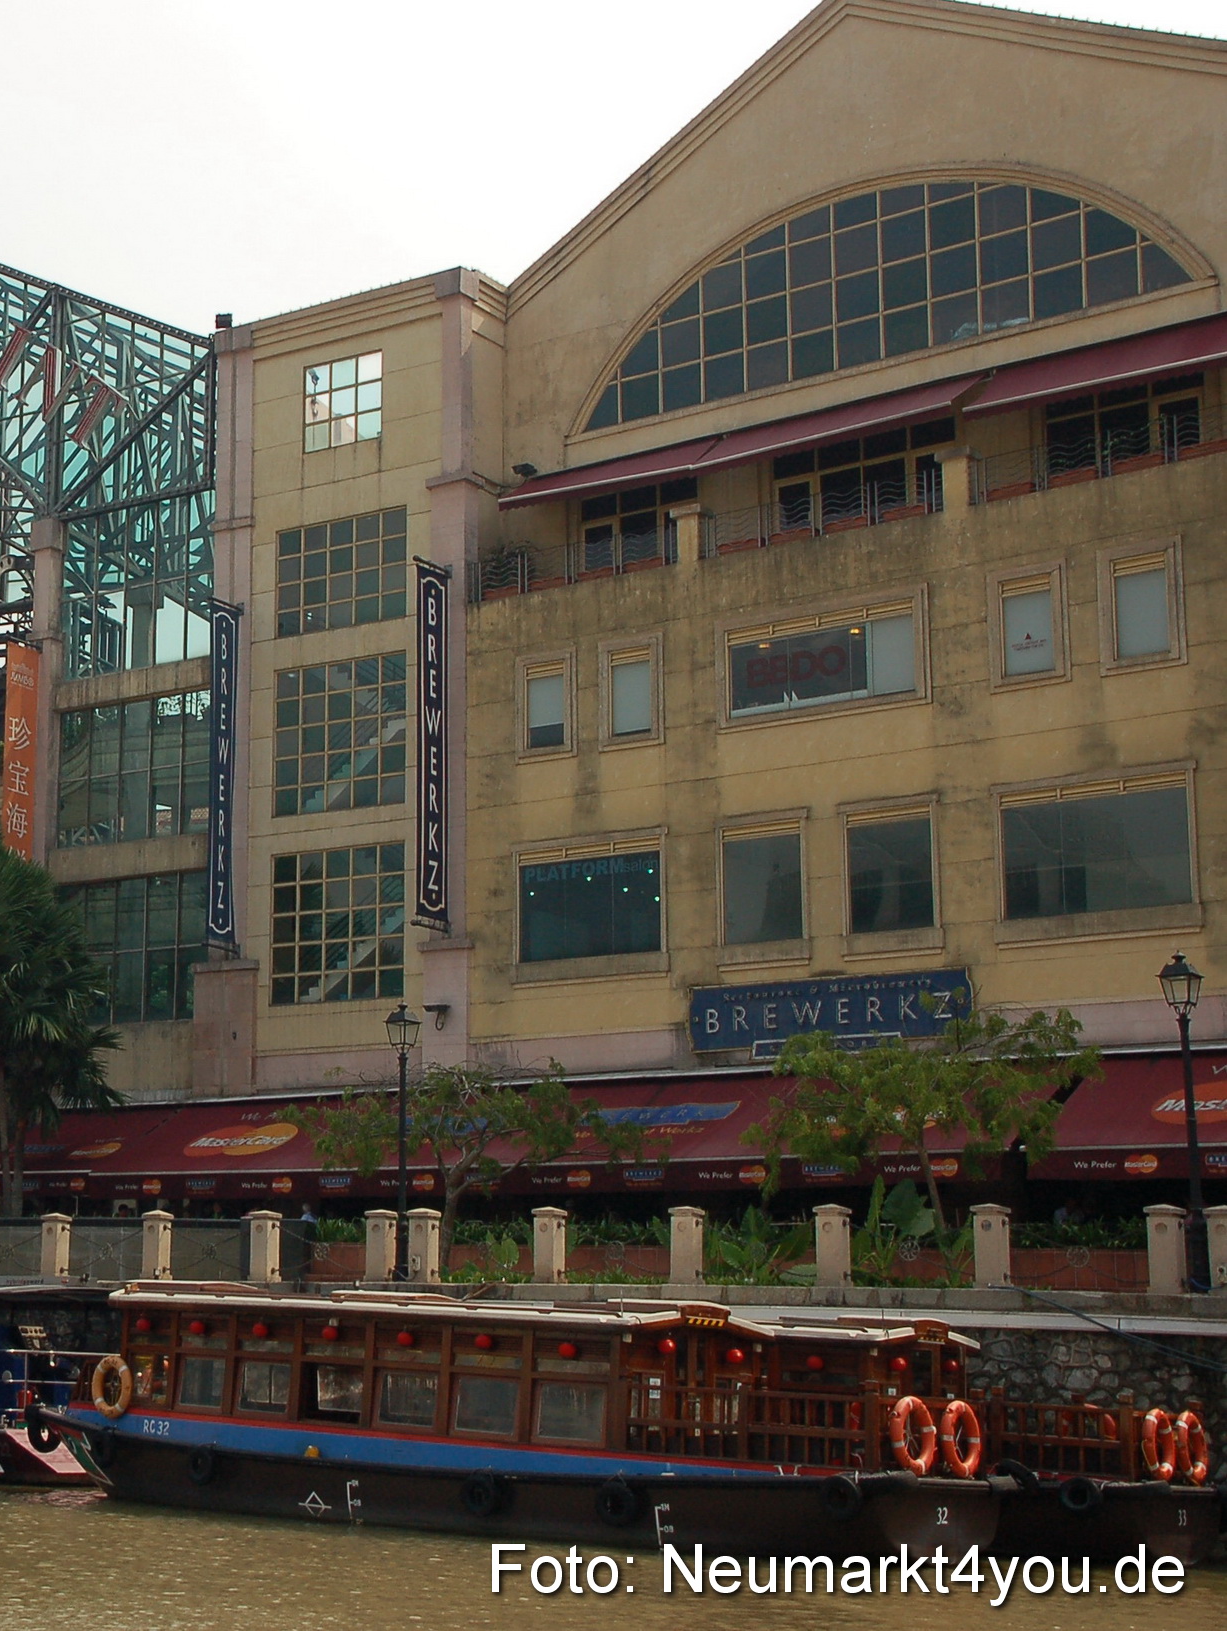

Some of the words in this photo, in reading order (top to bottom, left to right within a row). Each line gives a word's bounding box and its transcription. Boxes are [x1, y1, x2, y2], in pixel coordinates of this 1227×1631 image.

[424, 597, 442, 891] BREWERKZ
[216, 633, 229, 909] BREWERKZ
[706, 991, 952, 1033] BREWERKZ
[143, 1419, 156, 1434] RC
[157, 1421, 170, 1436] 32
[936, 1506, 948, 1525] 32
